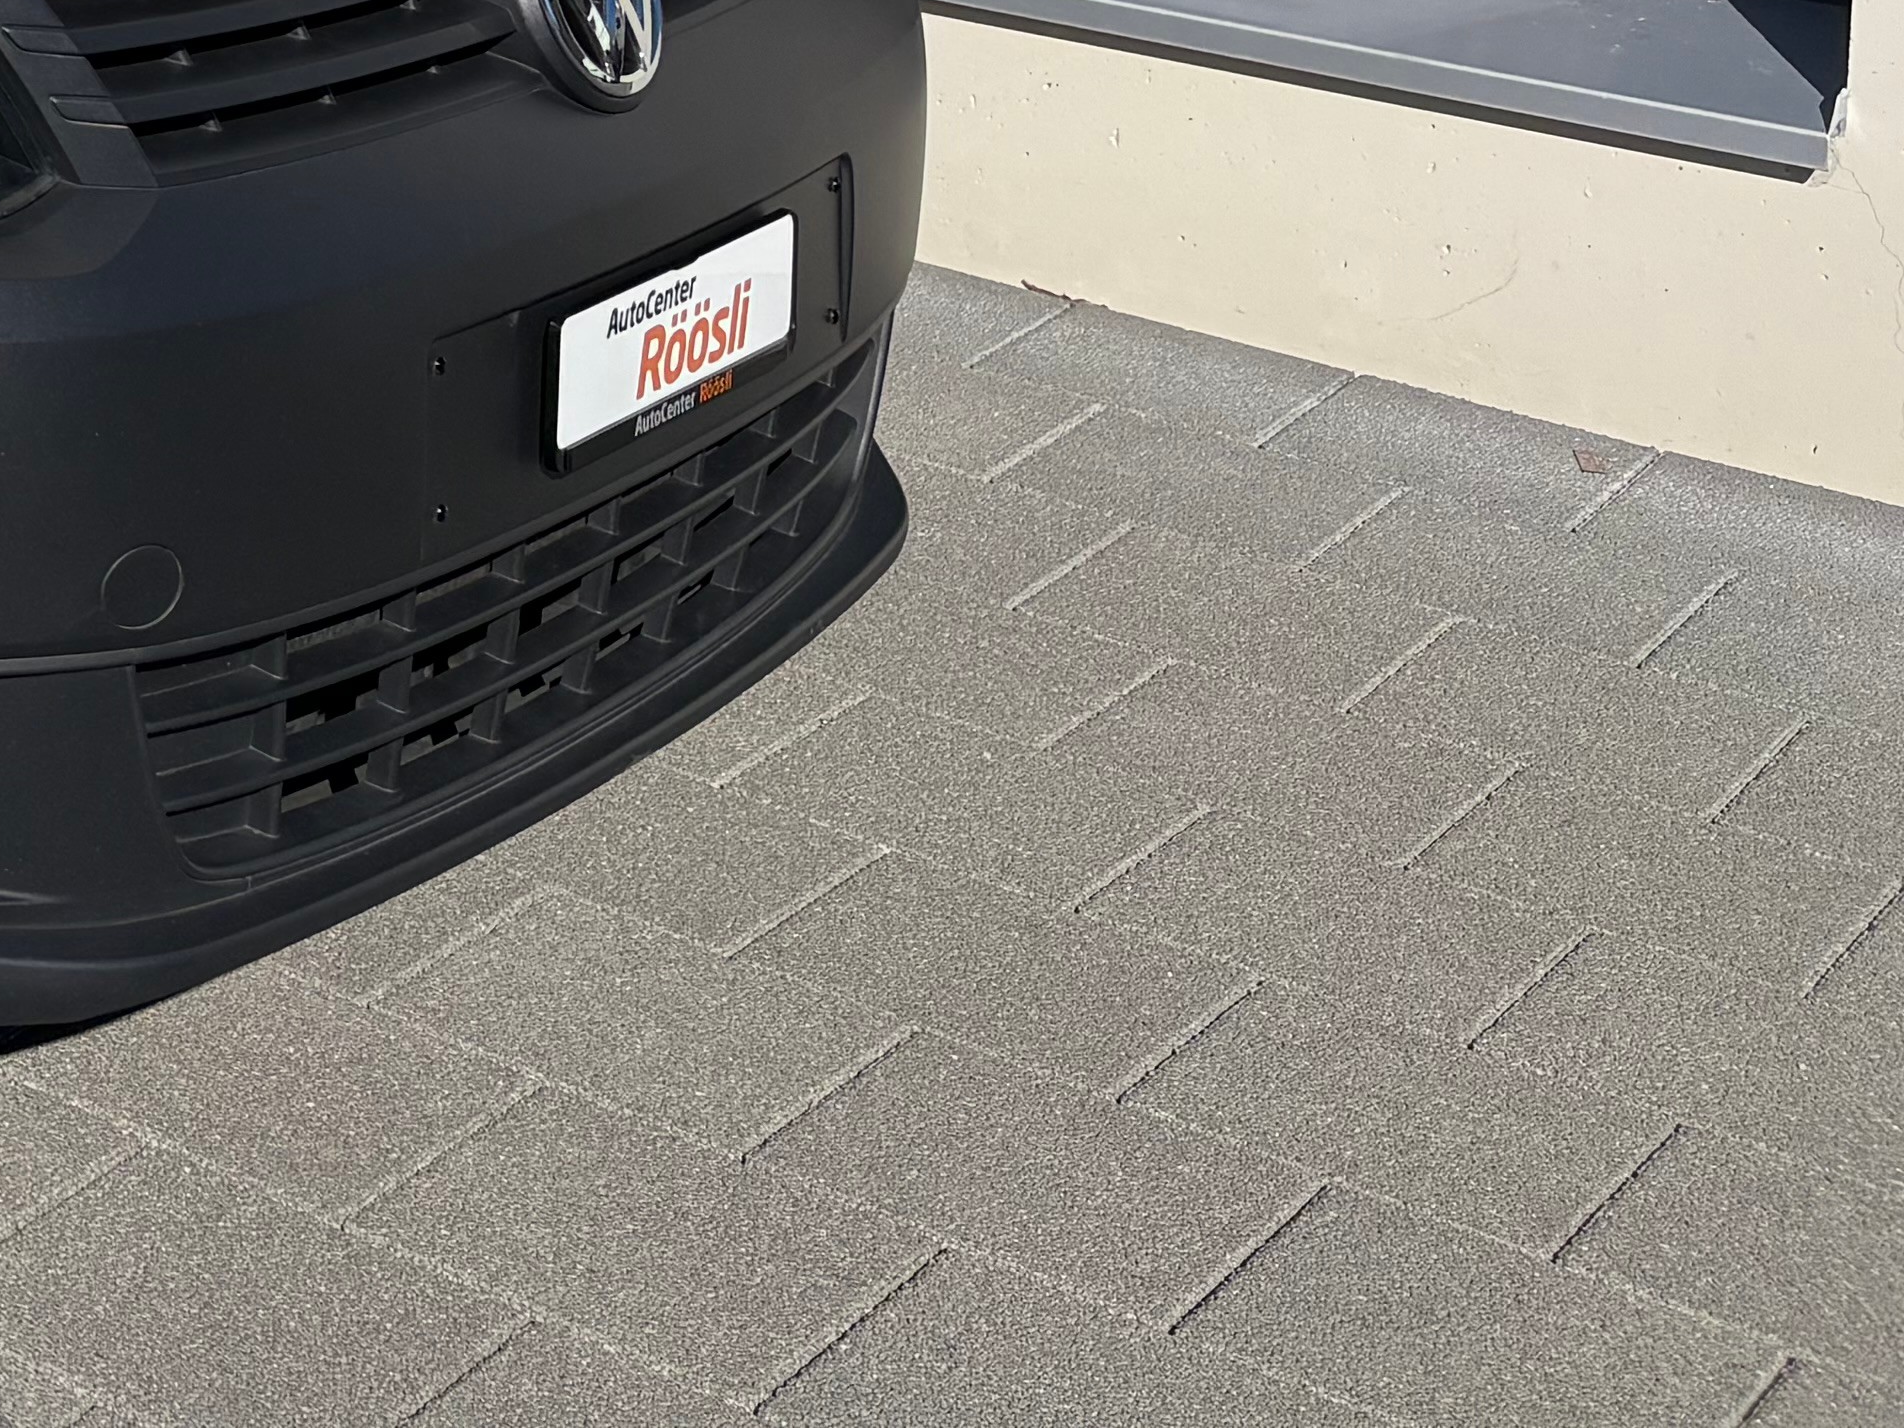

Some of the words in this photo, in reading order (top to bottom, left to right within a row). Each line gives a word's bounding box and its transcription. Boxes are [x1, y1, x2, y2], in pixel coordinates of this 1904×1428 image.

[607, 276, 697, 339] AutoCenter
[636, 278, 752, 401] Röösli
[634, 391, 696, 437] AutoCenter
[699, 369, 734, 404] Röösli
